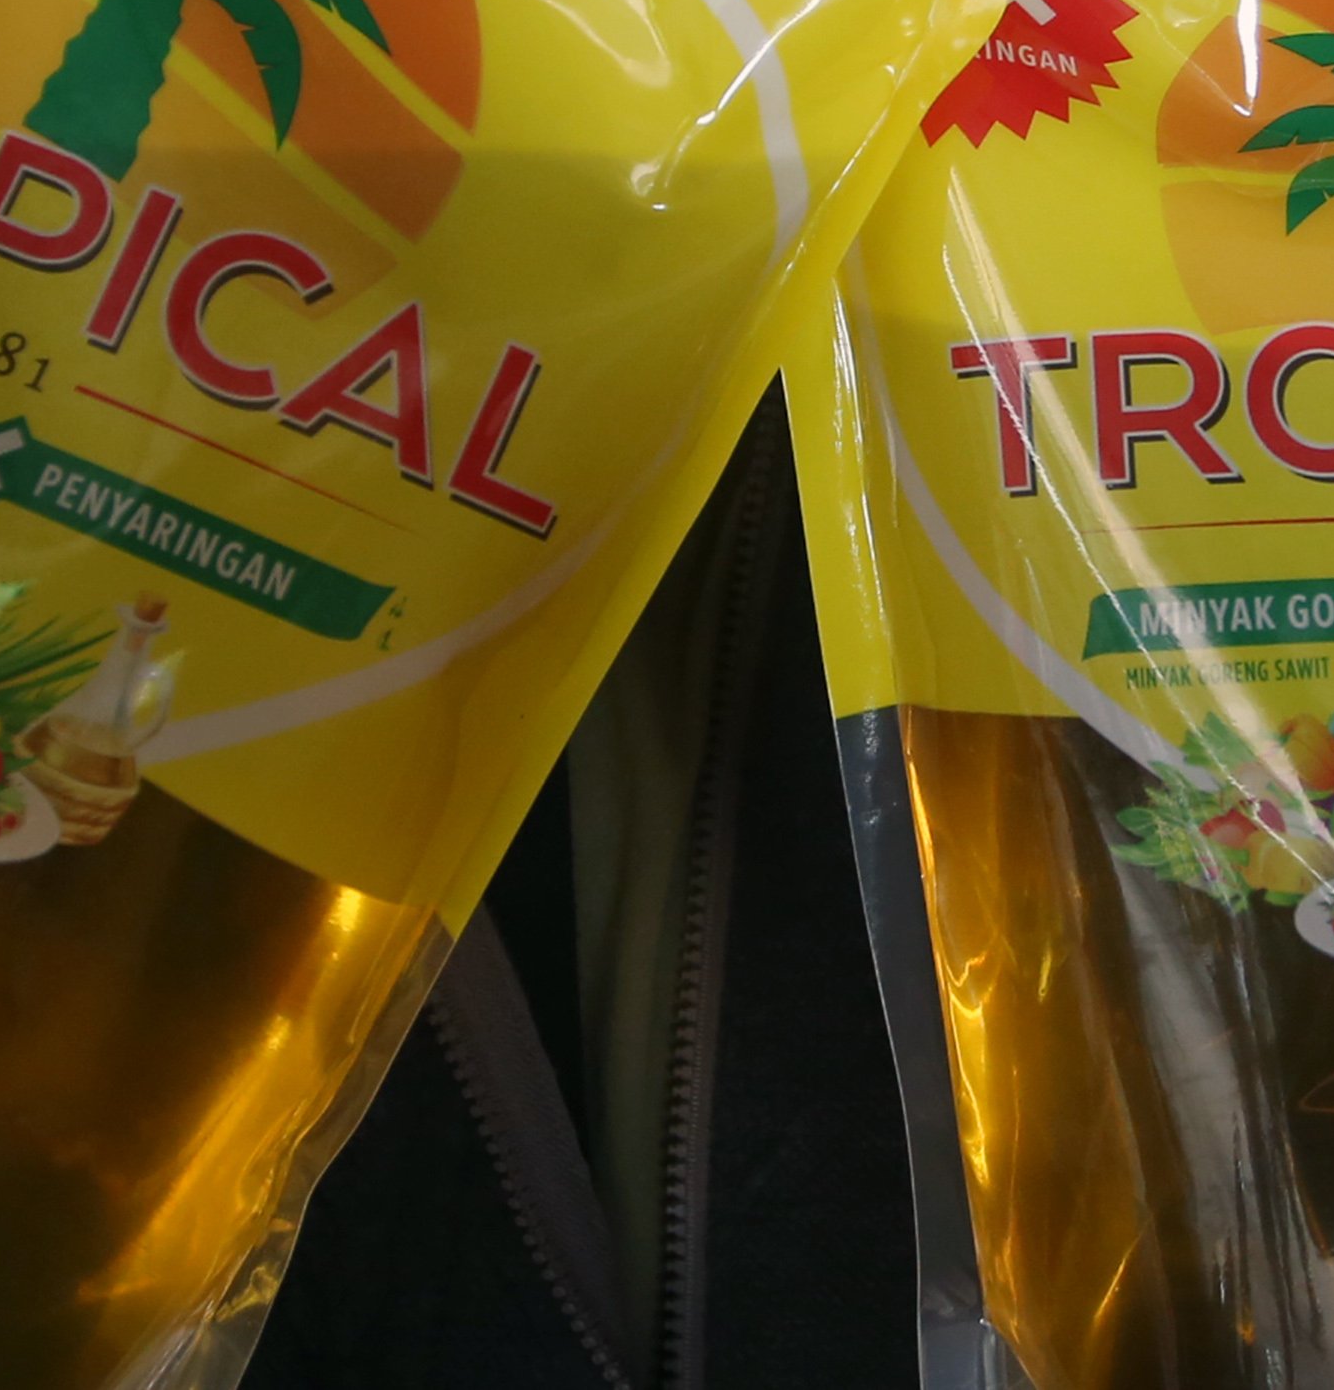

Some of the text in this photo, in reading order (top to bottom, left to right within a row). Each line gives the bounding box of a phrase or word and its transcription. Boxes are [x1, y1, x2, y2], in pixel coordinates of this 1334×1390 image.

[976, 38, 1078, 77] INGAN
[33, 463, 298, 602] PENYARINGAN
[1139, 595, 1275, 637] MINYAK
[1126, 657, 1331, 689] MINYAK GORENG SAWIT
